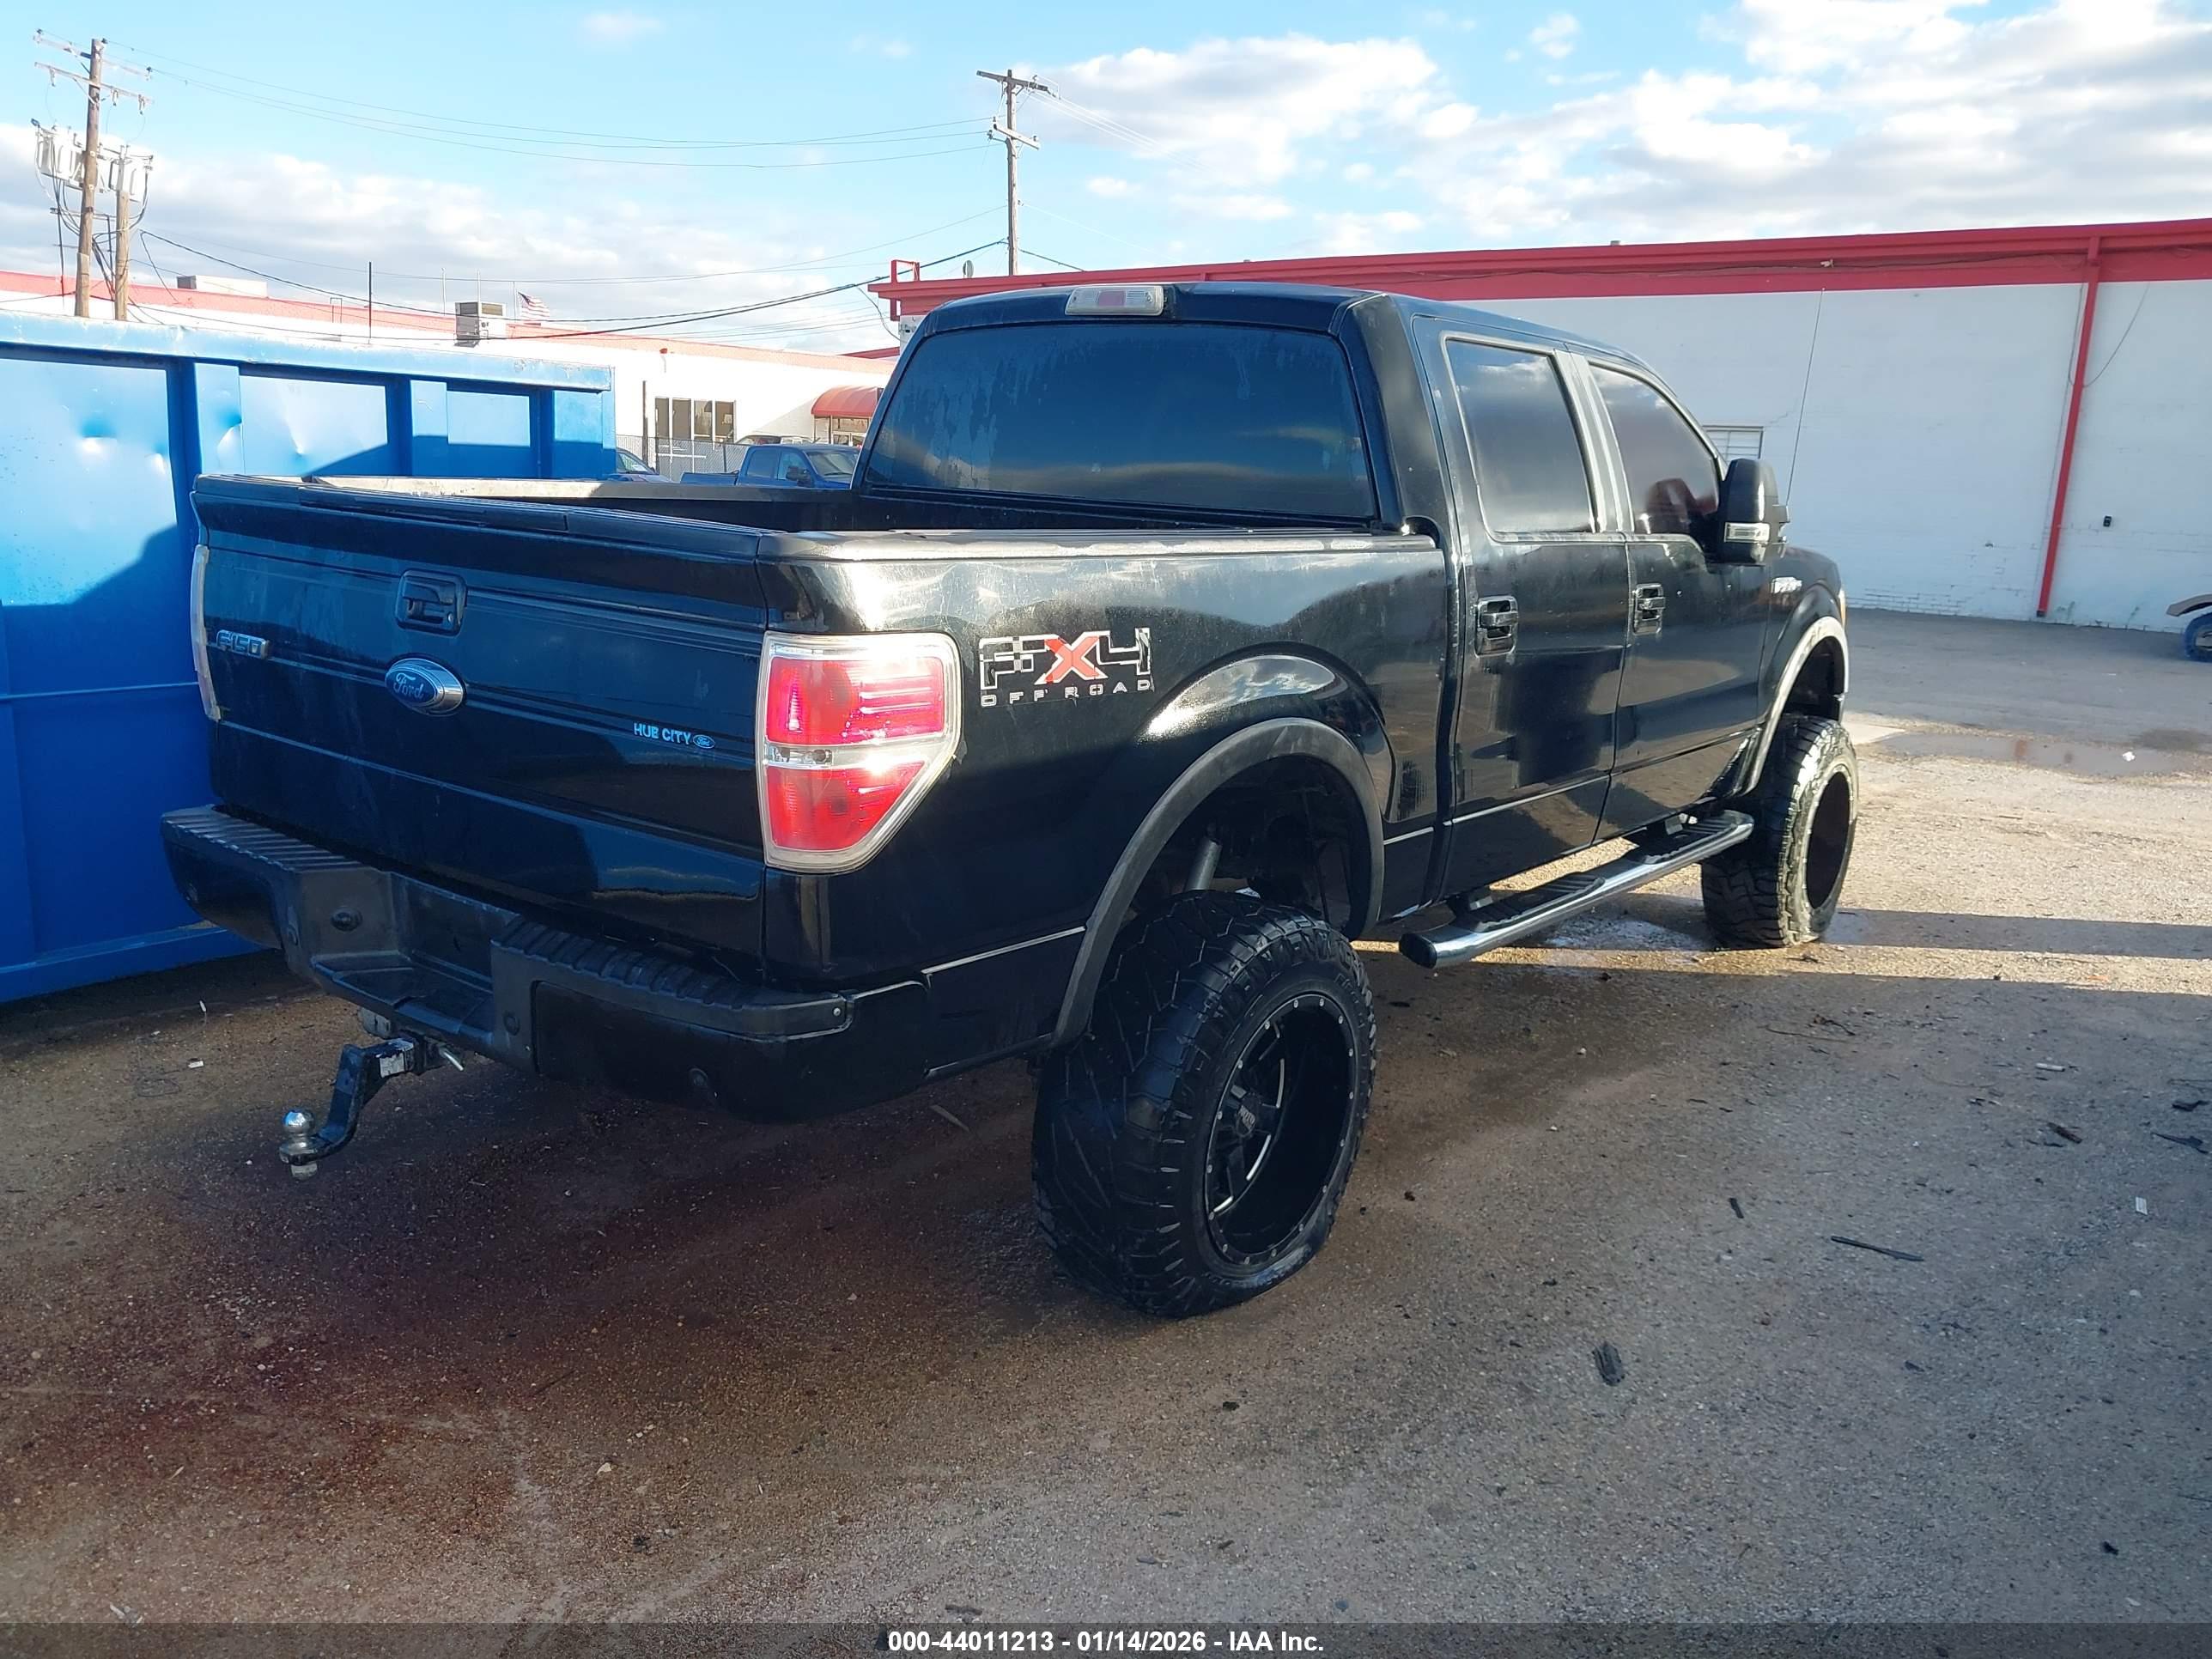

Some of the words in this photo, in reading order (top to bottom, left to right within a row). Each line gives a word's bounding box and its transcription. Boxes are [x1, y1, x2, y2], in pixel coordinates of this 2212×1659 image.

[979, 628, 1151, 690] FX4
[393, 672, 425, 699] Ford
[1065, 679, 1151, 698] ROAD
[634, 722, 659, 738] HUB
[662, 728, 690, 744] CITY
